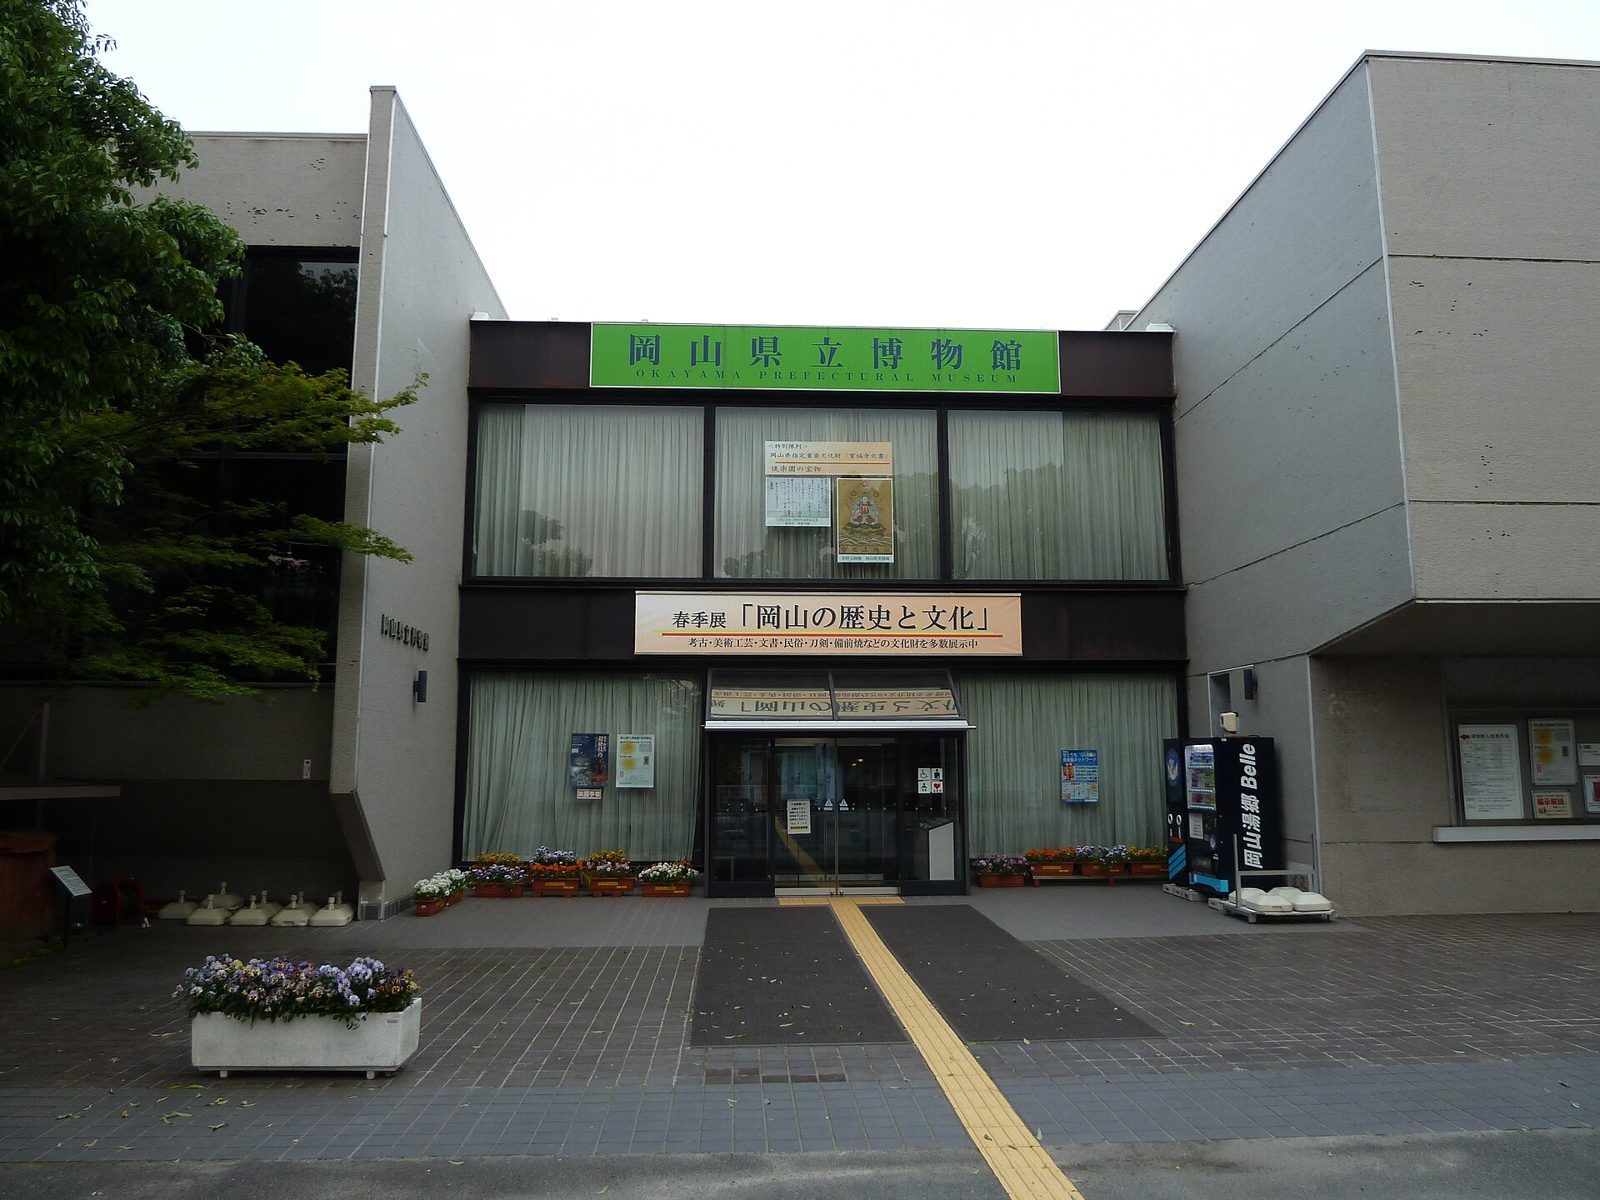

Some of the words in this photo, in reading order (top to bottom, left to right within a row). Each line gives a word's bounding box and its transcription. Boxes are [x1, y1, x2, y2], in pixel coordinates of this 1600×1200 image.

[629, 334, 1022, 371] 岡山県立博物館
[636, 369, 741, 379] OKAYAMA
[759, 371, 914, 382] PREFECTURAL
[931, 373, 1017, 384] MUSEUM
[688, 637, 978, 649] 考古・美術工芸・文書・民俗・刀剣・備前焼などの文化財を多数展示中
[1239, 743, 1258, 790] Belle
[1240, 793, 1264, 869] 岡山湯郷
